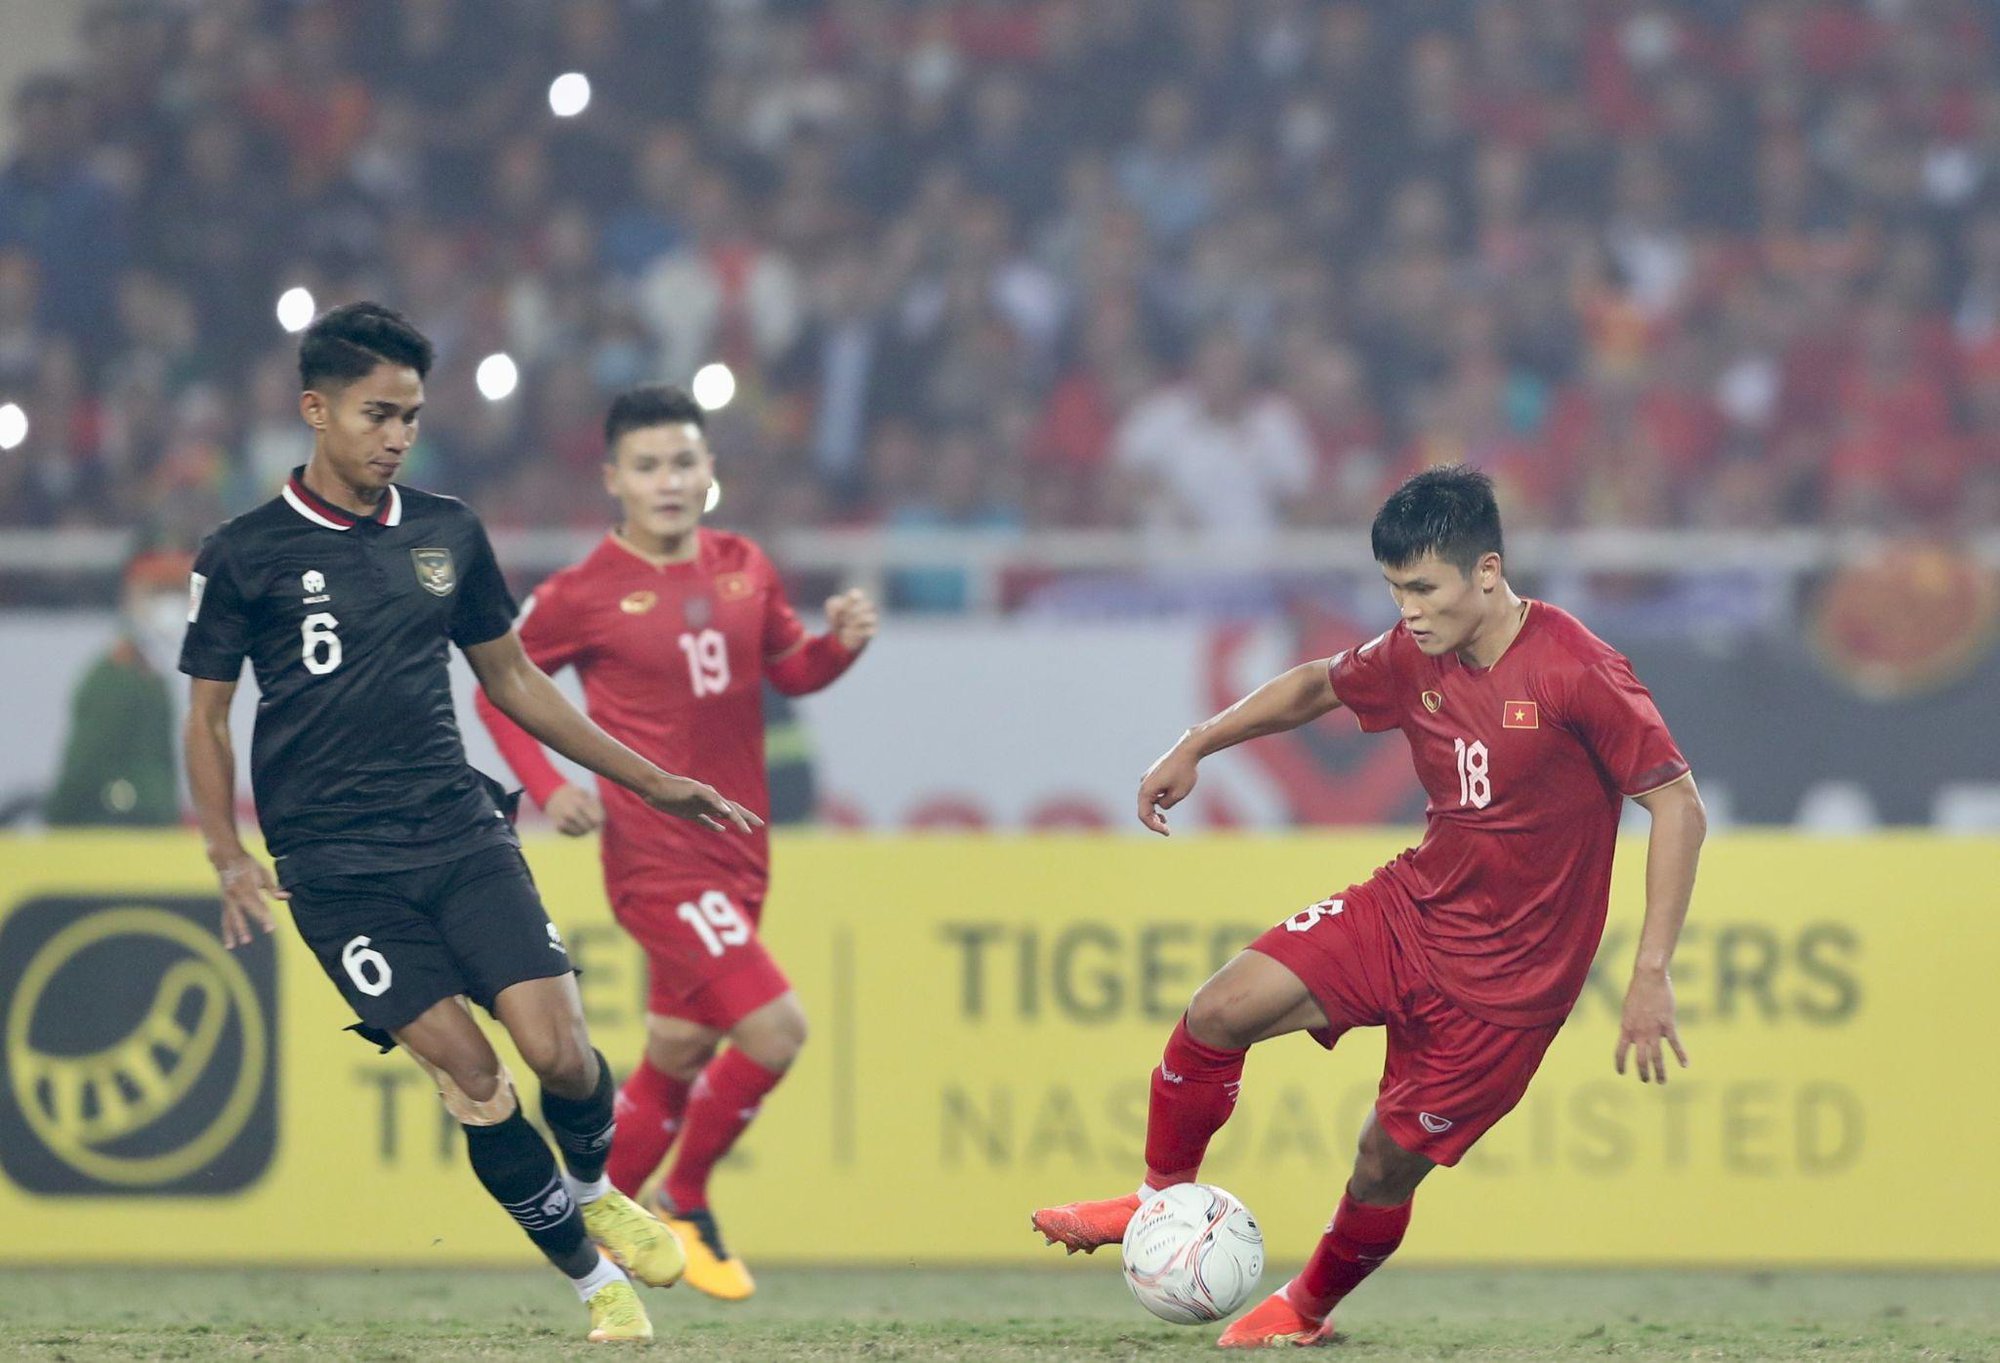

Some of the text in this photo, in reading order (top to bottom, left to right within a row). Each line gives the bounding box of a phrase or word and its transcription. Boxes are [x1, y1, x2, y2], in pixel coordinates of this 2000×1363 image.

[301, 612, 342, 675] 6
[678, 629, 731, 698] 19
[1455, 738, 1492, 809] 18
[677, 890, 750, 957] 19
[342, 935, 392, 997] 6
